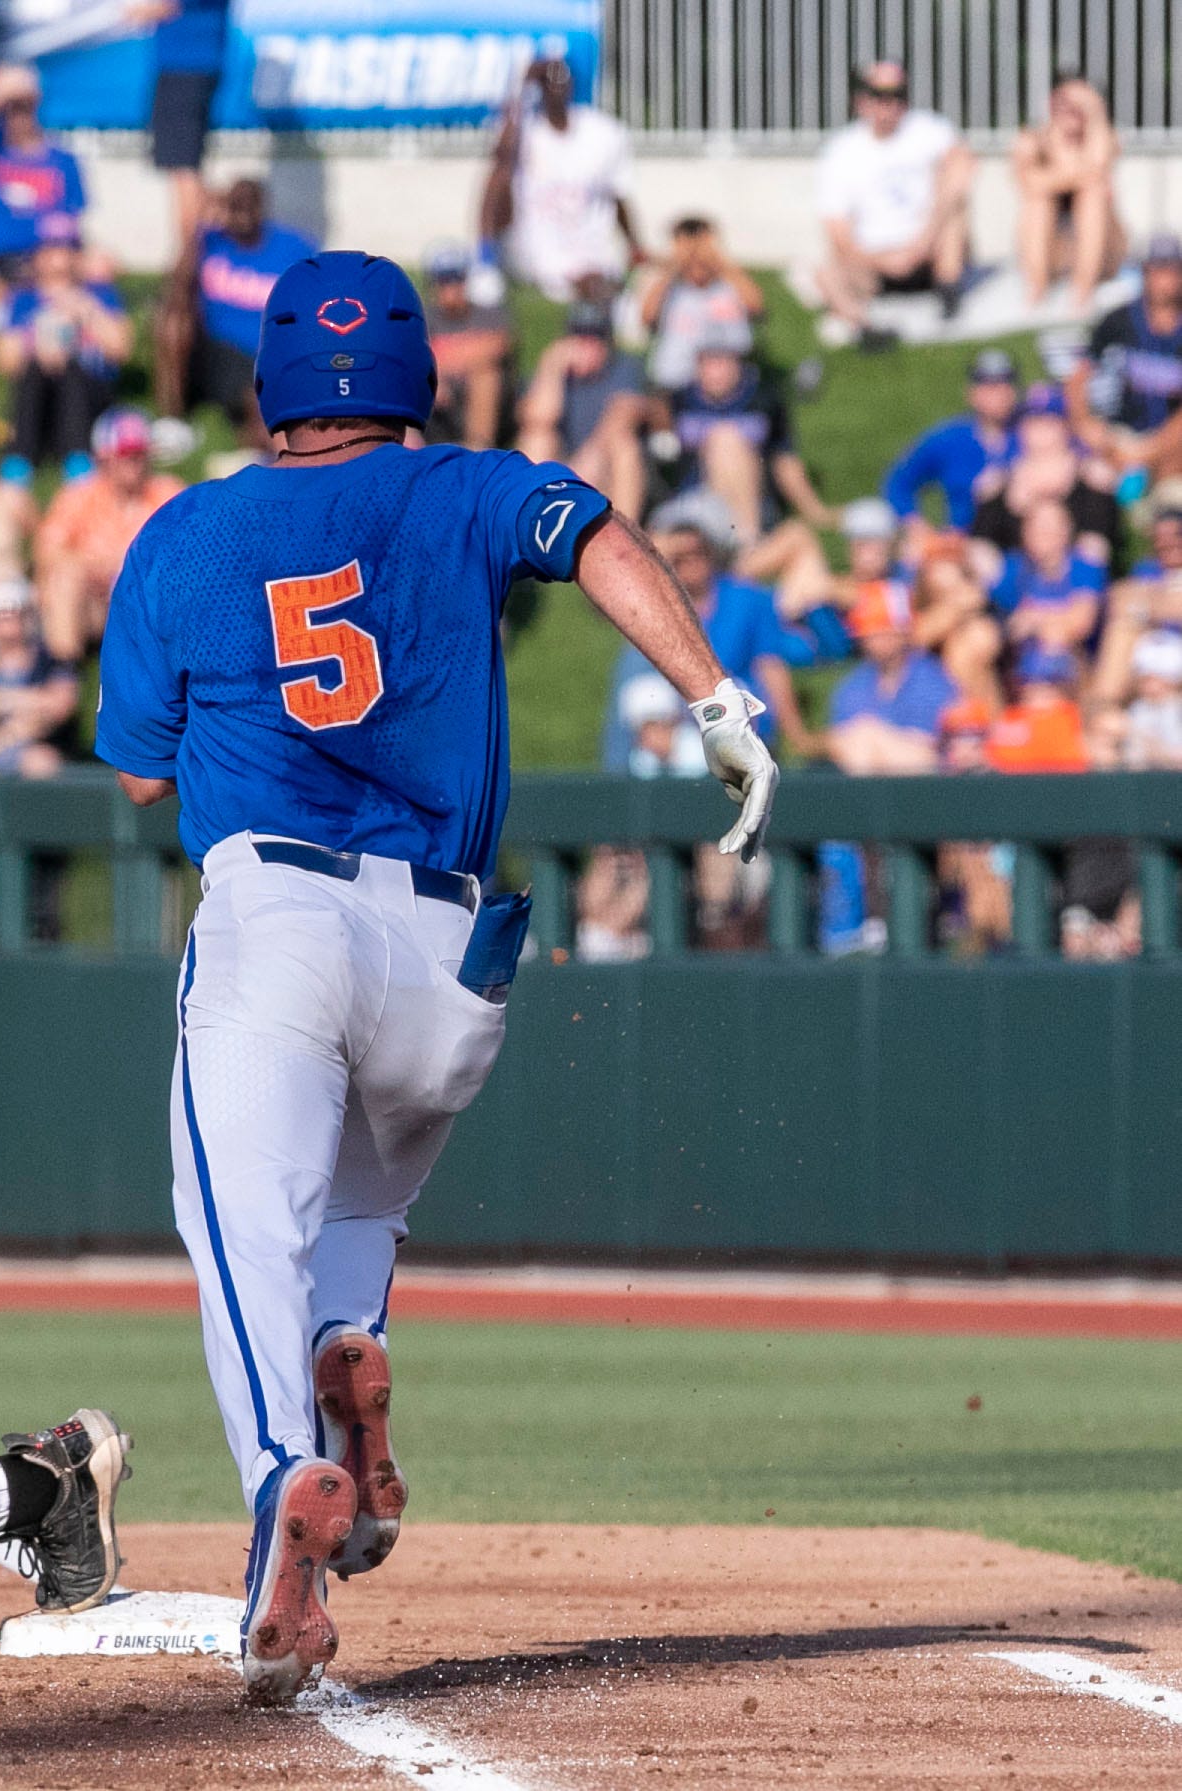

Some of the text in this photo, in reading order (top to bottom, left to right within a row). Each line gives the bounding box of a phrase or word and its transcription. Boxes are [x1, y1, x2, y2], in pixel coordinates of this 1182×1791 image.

[339, 378, 350, 396] 5
[265, 558, 385, 732] 5
[94, 1634, 198, 1649] F GAINESVILLE
